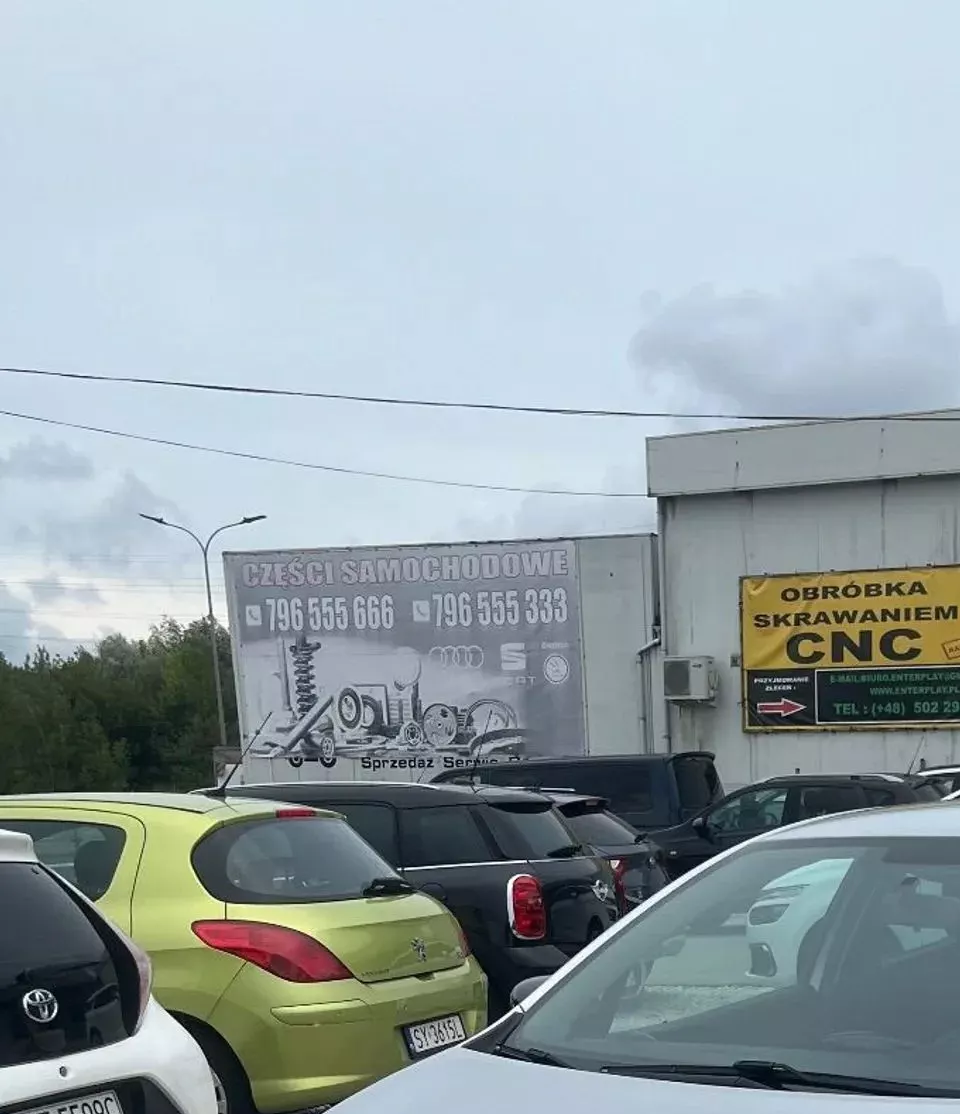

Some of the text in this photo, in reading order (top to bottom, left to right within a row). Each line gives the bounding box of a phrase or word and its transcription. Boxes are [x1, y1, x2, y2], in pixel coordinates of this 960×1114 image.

[241, 550, 569, 590] CZĘŚCI SAMOCHODOWE
[780, 580, 928, 602] OBRÓBKA
[265, 594, 395, 632] 796 555 666
[431, 587, 568, 627] 796 555 333
[753, 605, 958, 628] SKRAWANIEM
[786, 628, 922, 664] CNC
[869, 686, 960, 695] WWW.ENTERPLAY.PL
[833, 702, 860, 715] TEL
[871, 702, 906, 718] (+48)
[913, 701, 939, 714] 502
[413, 1025, 429, 1049] SY
